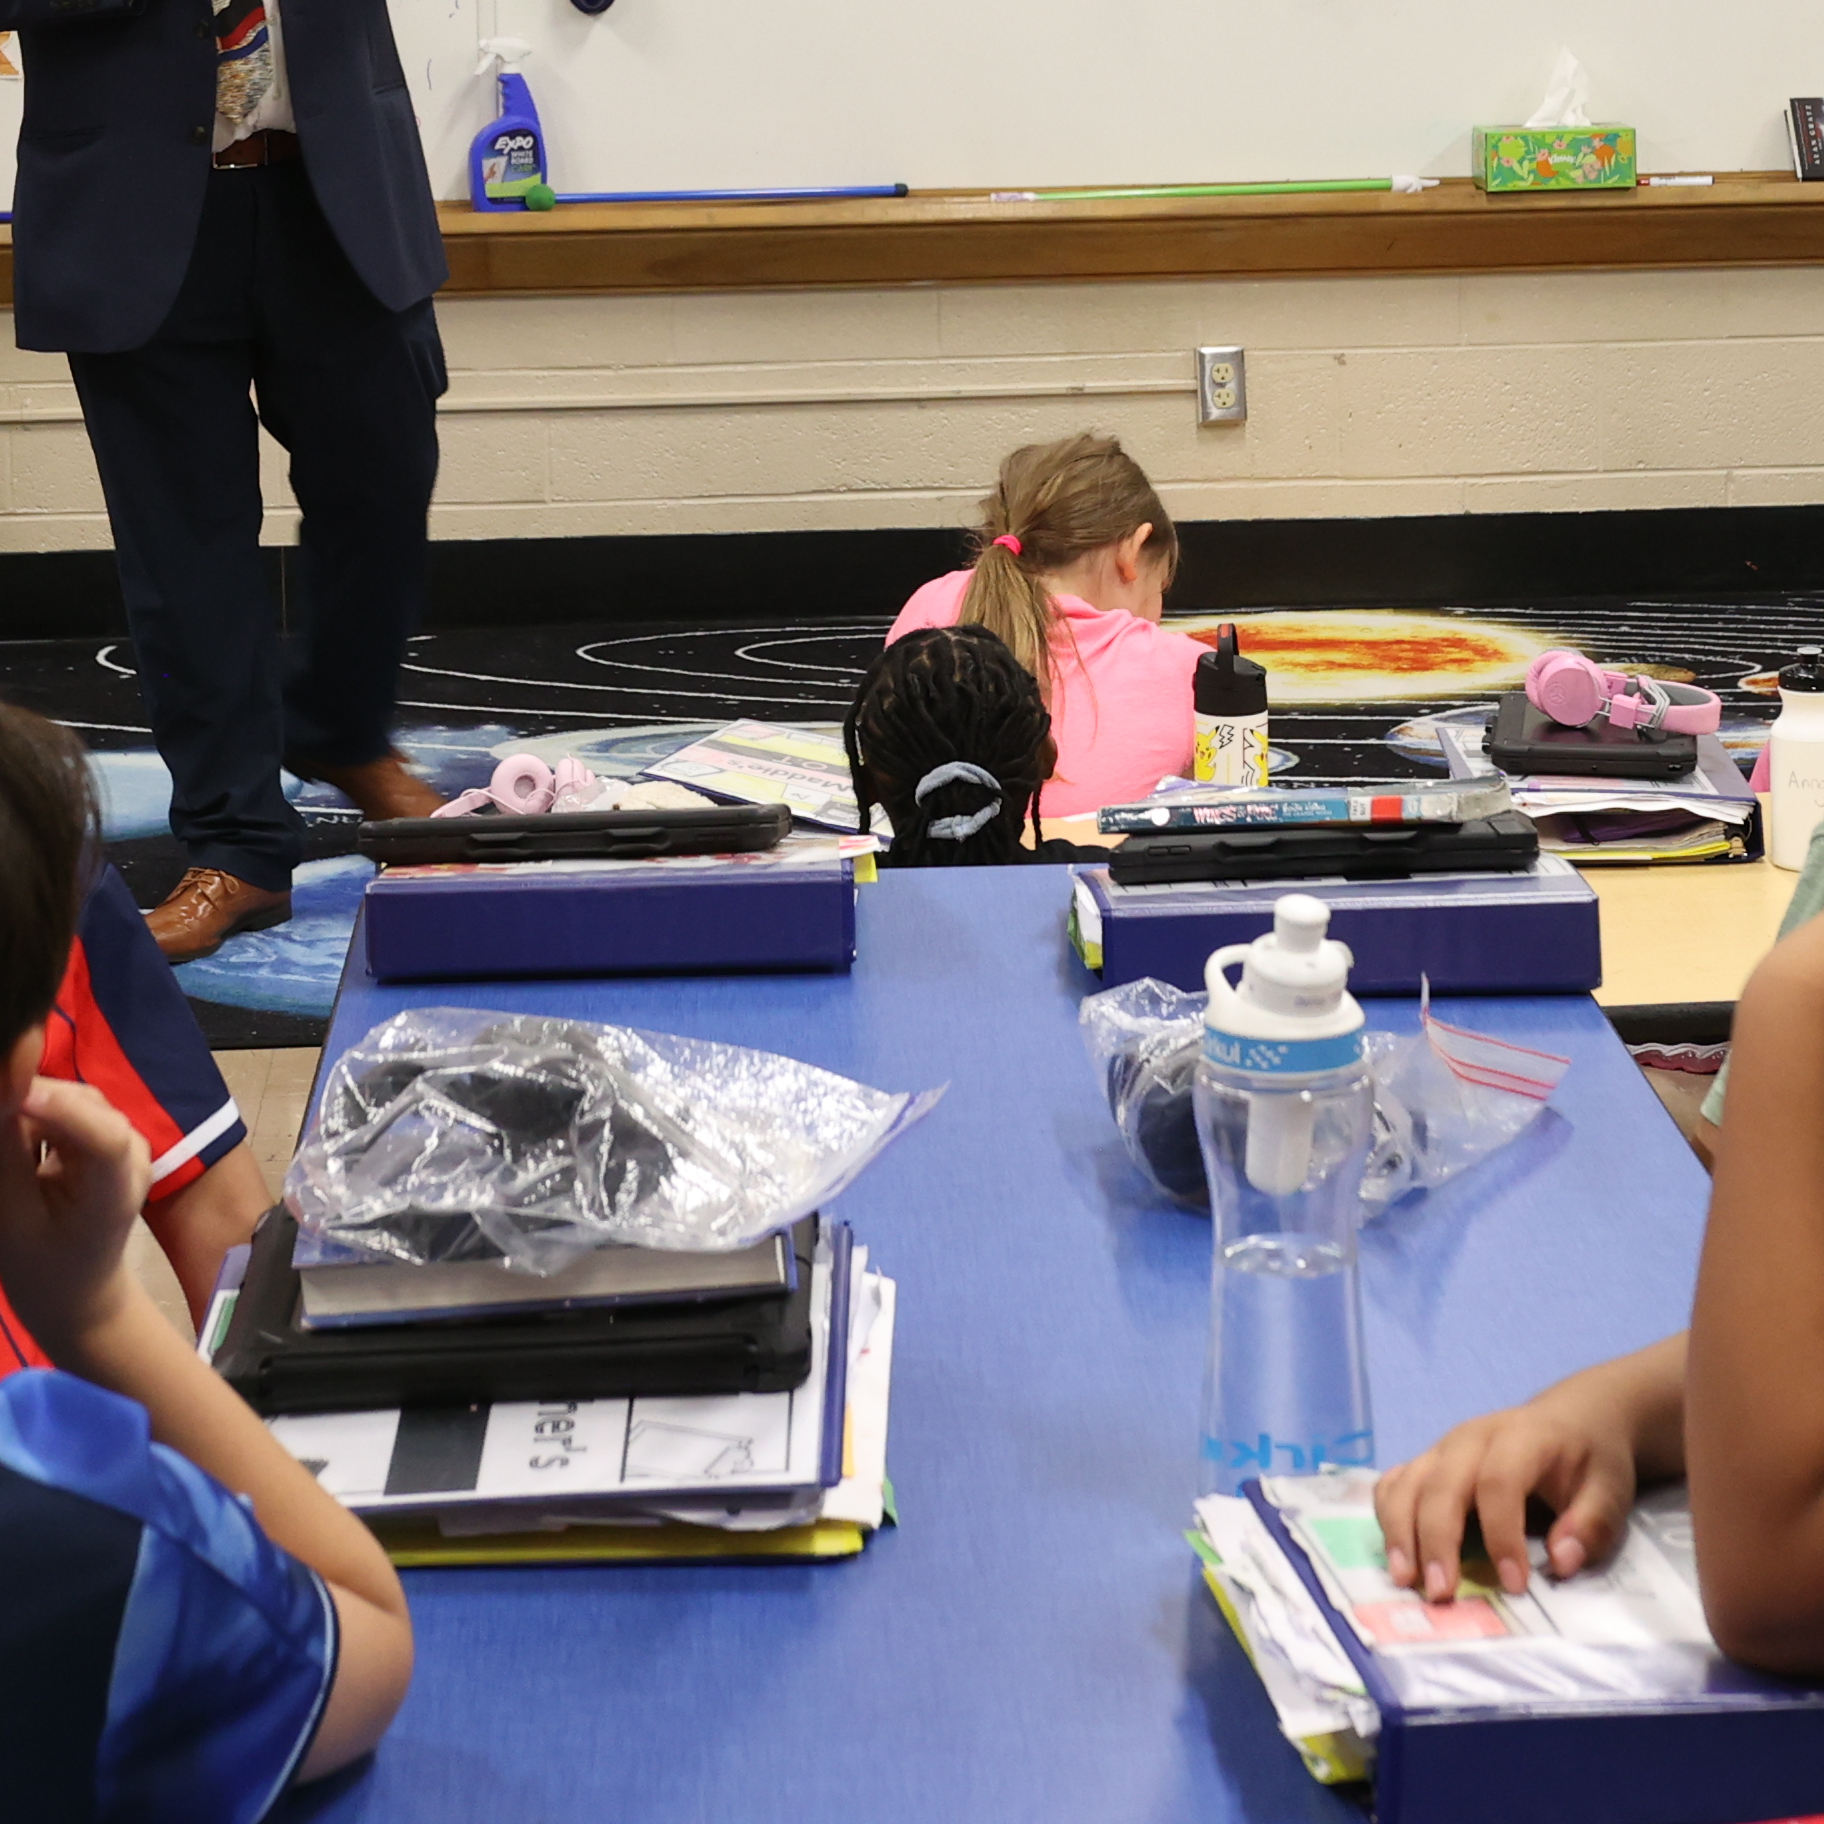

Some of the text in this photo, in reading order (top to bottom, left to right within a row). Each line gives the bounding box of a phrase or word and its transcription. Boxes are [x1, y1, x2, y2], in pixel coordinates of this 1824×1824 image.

[494, 136, 533, 154] EXPO
[1811, 138, 1821, 165] ALAN
[726, 756, 853, 793] Maddie's
